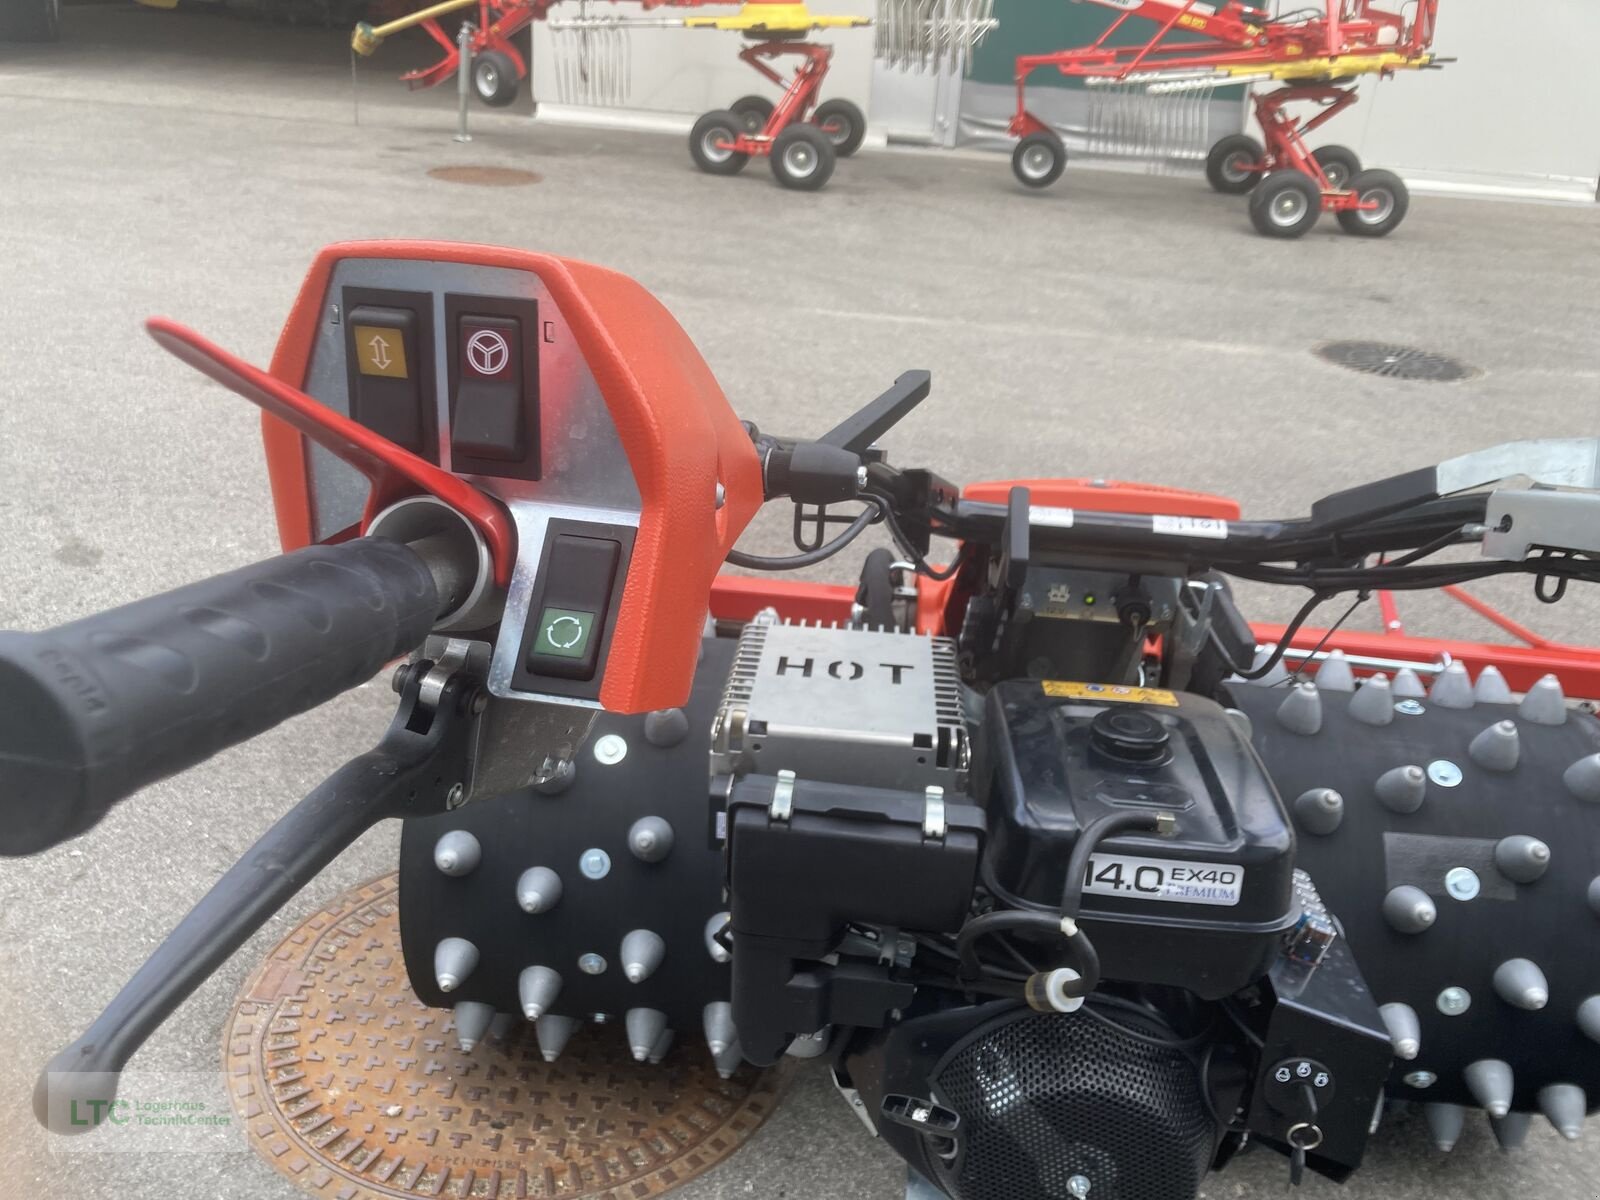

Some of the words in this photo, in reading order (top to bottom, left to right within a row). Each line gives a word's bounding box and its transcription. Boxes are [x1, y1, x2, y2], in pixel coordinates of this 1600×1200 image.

[776, 656, 915, 685] HOT
[1084, 860, 1164, 893] 14.0
[1171, 867, 1236, 885] EX40
